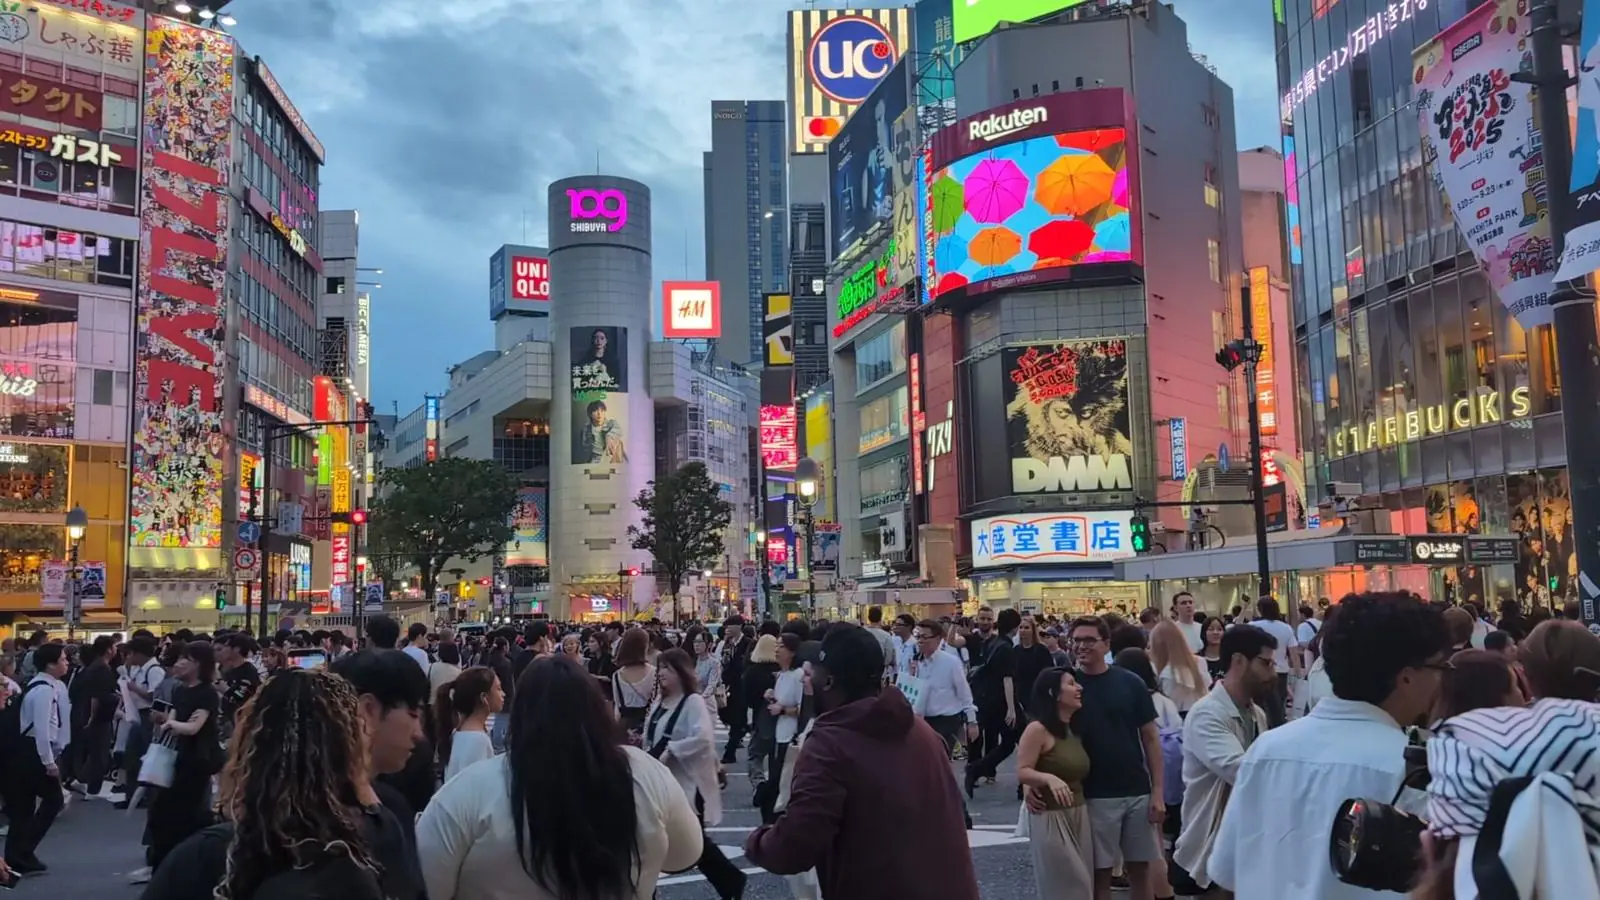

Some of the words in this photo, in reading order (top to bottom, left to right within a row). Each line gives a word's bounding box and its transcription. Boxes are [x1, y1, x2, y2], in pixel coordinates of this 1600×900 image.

[40, 16, 133, 63] しゃぶ葉
[0, 79, 97, 118] タクト
[969, 106, 1047, 141] Rakuten
[1449, 117, 1505, 165] 2025
[50, 134, 122, 168] ガスト
[566, 189, 628, 232] 109
[570, 222, 607, 232] SHIBUYA
[1494, 207, 1518, 224] PARK
[516, 262, 547, 277] UNI
[516, 280, 549, 297] QLO
[358, 298, 367, 318] BIC
[679, 300, 706, 318] H&M
[358, 320, 367, 365] CAMERA
[1335, 387, 1532, 456] STARBUCKS
[1012, 454, 1132, 493] DMM
[291, 542, 310, 564] LUSH
[977, 520, 1121, 557] 大盛堂書店
